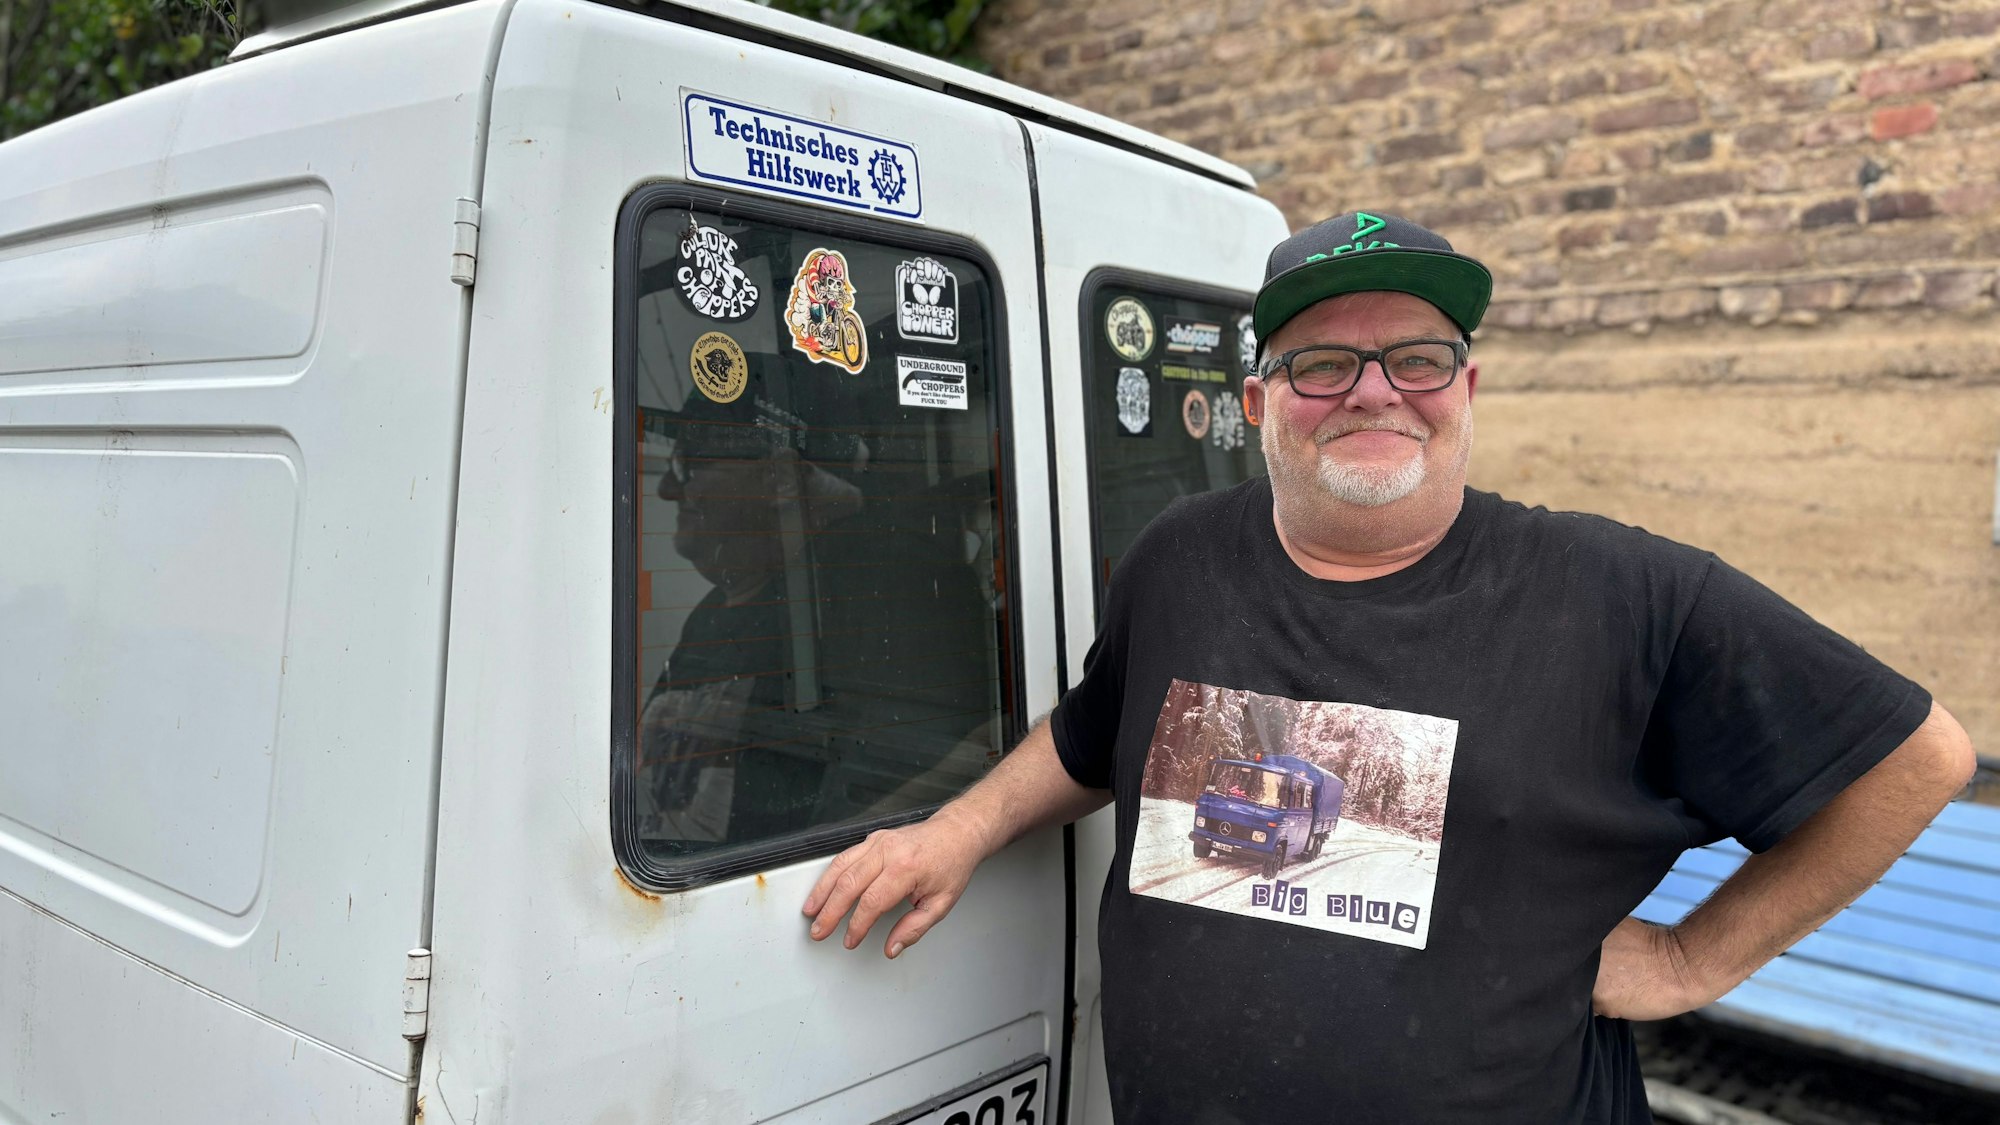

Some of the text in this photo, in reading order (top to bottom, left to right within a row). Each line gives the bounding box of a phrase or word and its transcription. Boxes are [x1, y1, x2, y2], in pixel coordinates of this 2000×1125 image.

[709, 106, 859, 166] Technisches
[746, 147, 862, 198] Hilfswerk
[681, 226, 738, 266] CULTURE
[901, 301, 954, 320] CHOPPER
[900, 359, 964, 374] UNDERGROUND
[921, 382, 965, 394] CHOPPERS
[921, 397, 935, 405] FUCK
[1253, 882, 1417, 931] Big Blue
